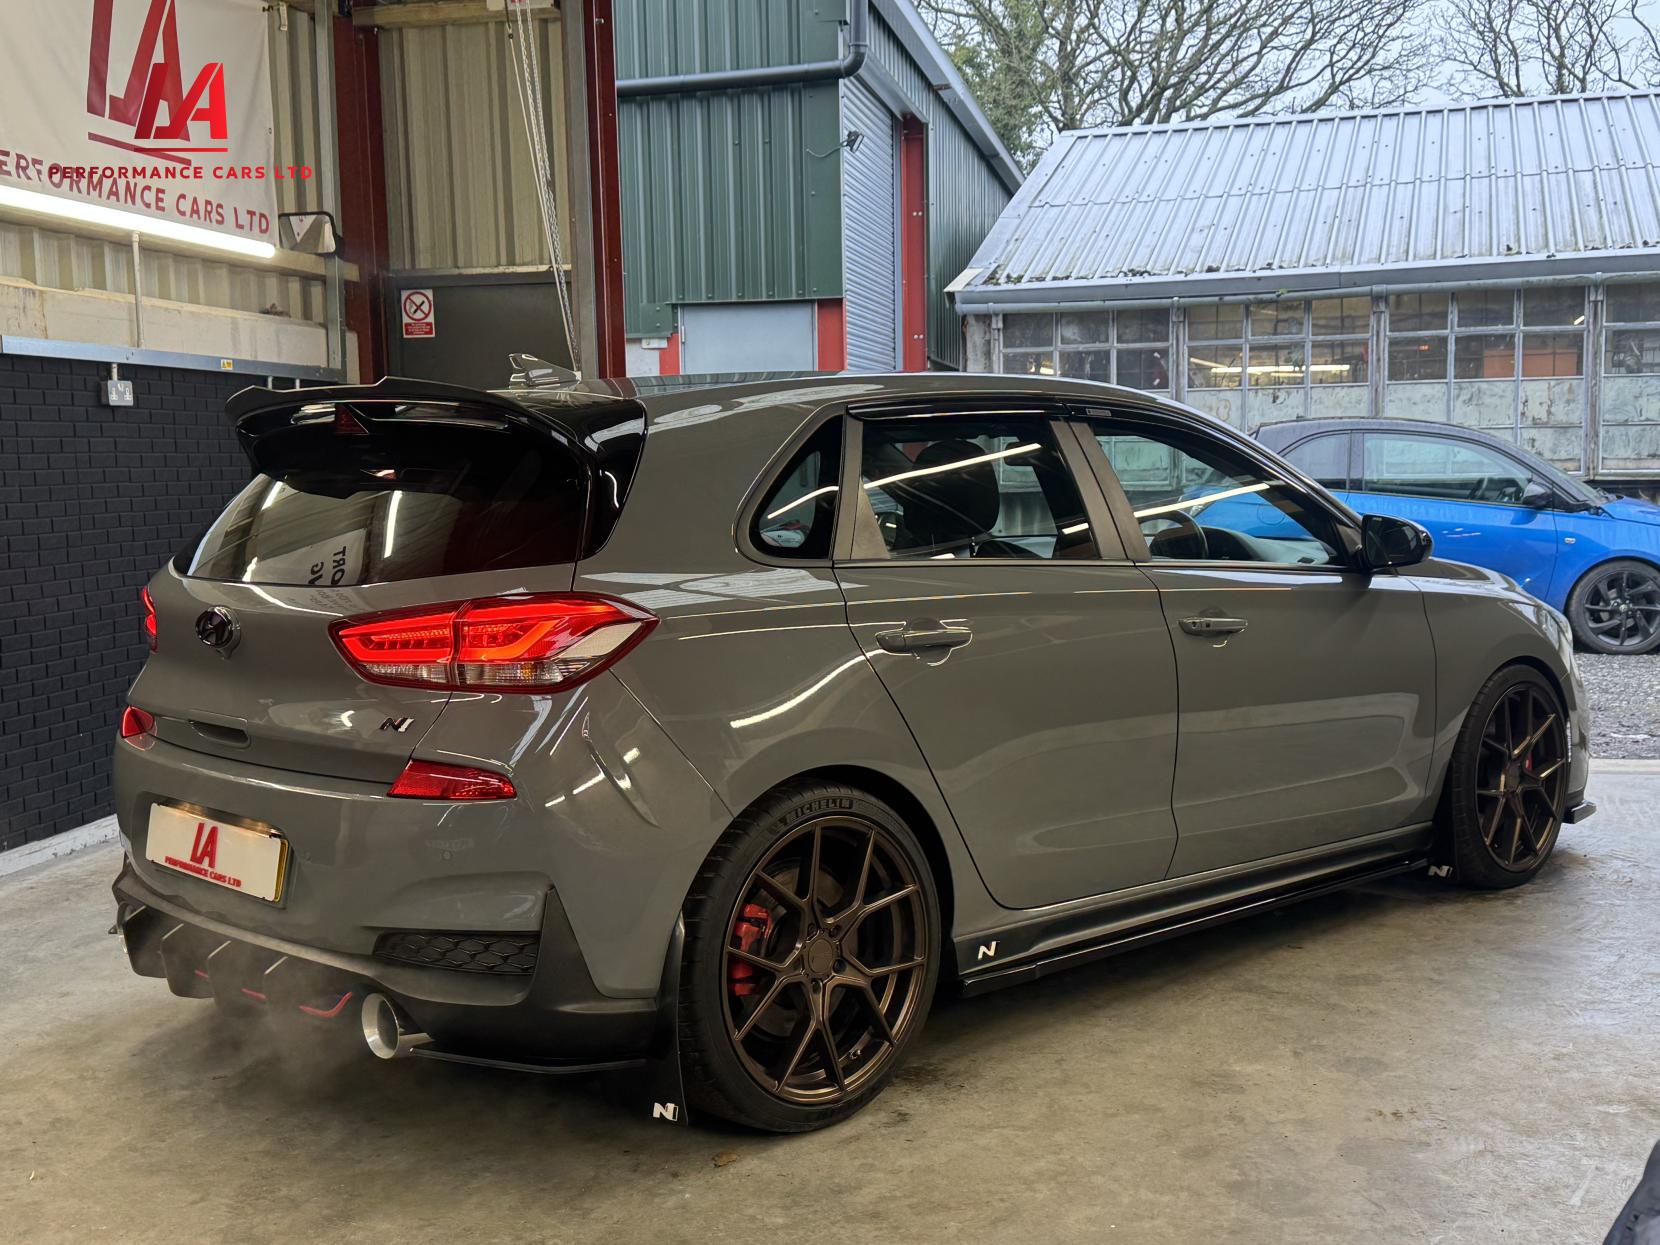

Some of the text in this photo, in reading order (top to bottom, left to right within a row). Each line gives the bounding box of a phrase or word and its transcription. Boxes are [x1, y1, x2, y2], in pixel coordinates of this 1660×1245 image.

[176, 194, 225, 225] CARS
[233, 206, 270, 235] LTD
[785, 798, 851, 825] MICHELIN
[190, 822, 218, 868] LA
[209, 871, 227, 883] CARS
[227, 876, 242, 888] LTD
